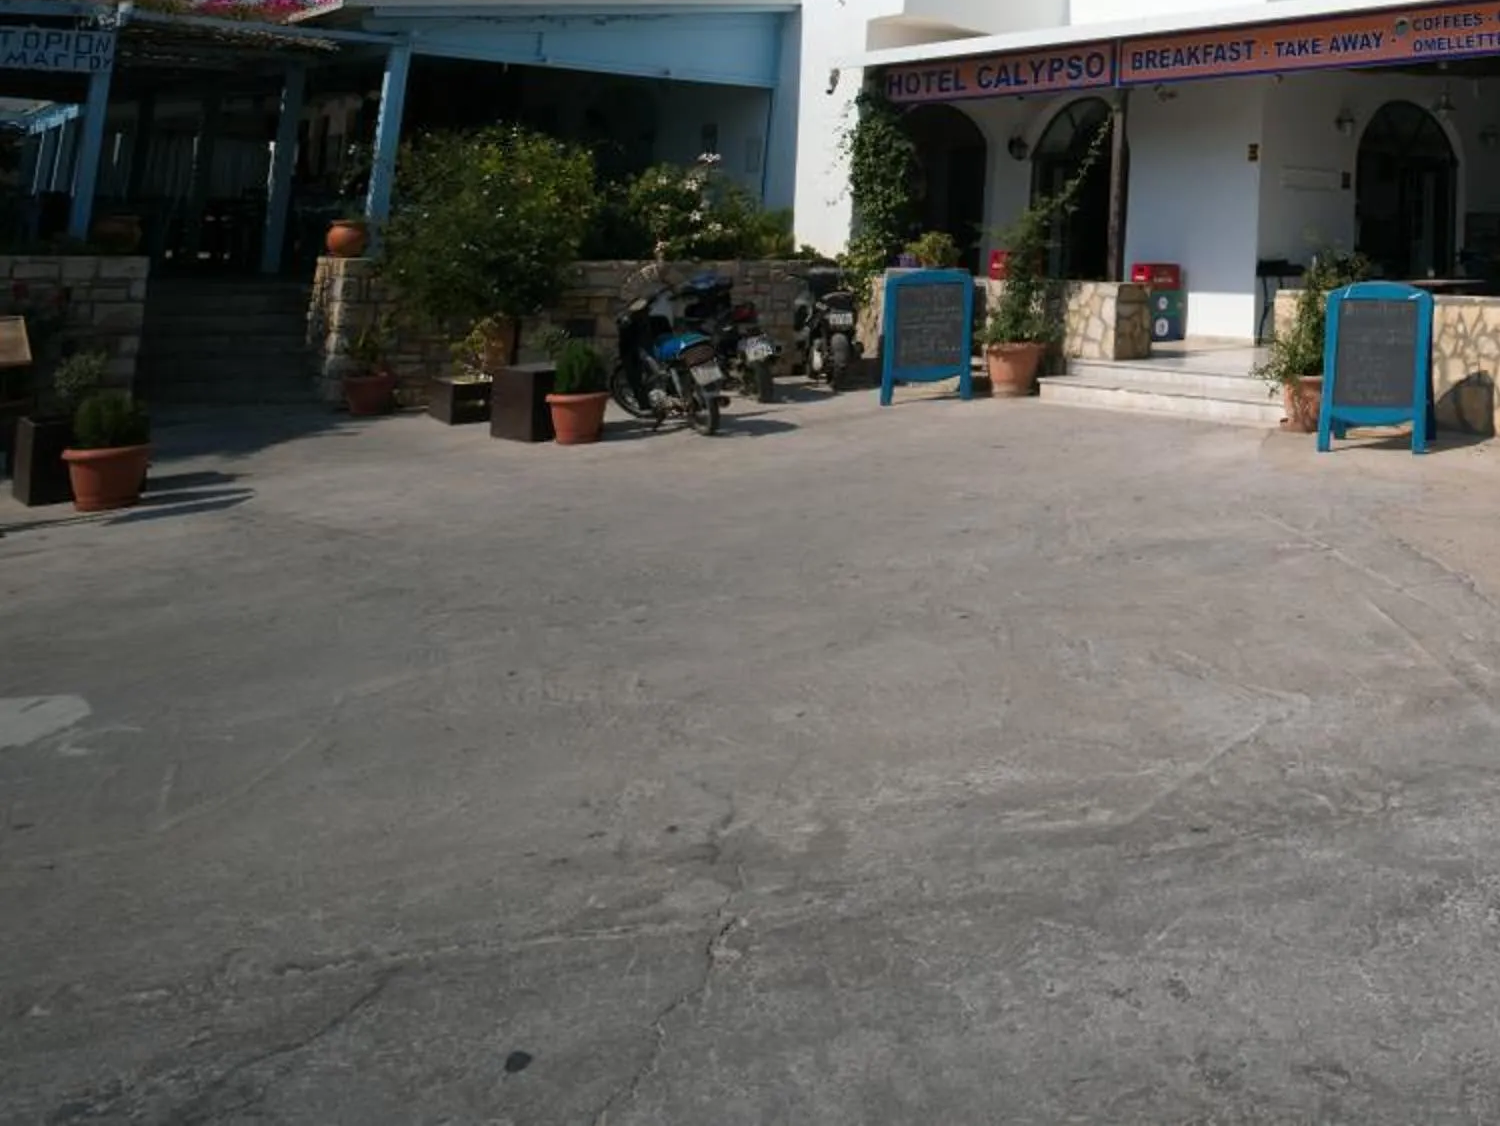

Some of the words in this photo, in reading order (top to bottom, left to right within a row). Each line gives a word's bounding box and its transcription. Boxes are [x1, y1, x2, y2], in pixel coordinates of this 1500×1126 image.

[1411, 12, 1484, 32] COFFEES
[1130, 39, 1256, 72] BREAKFAST
[1274, 39, 1322, 58] TAKE
[1328, 32, 1384, 54] AWAY
[887, 69, 966, 97] HOTEL
[976, 52, 1105, 89] CALYPSO
